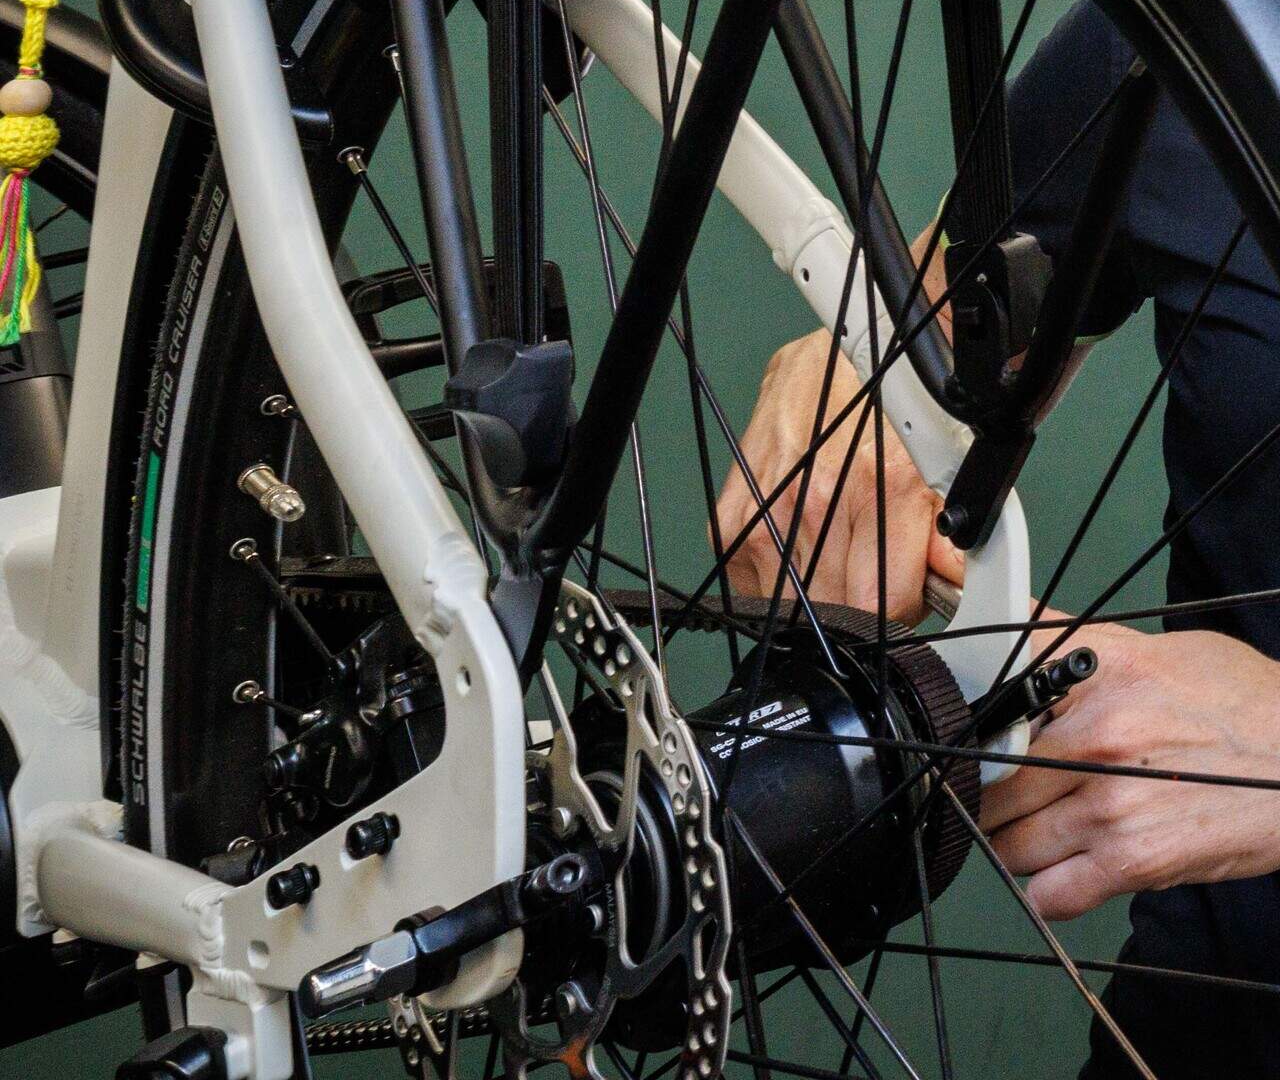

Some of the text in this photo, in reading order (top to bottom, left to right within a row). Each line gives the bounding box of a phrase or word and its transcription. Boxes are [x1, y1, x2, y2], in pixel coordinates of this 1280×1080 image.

[131, 621, 148, 806] SCHWALBE
[153, 371, 174, 448] ROAD
[168, 255, 203, 364] CRUISER
[762, 716, 787, 730] MADE
[795, 707, 809, 718] EU
